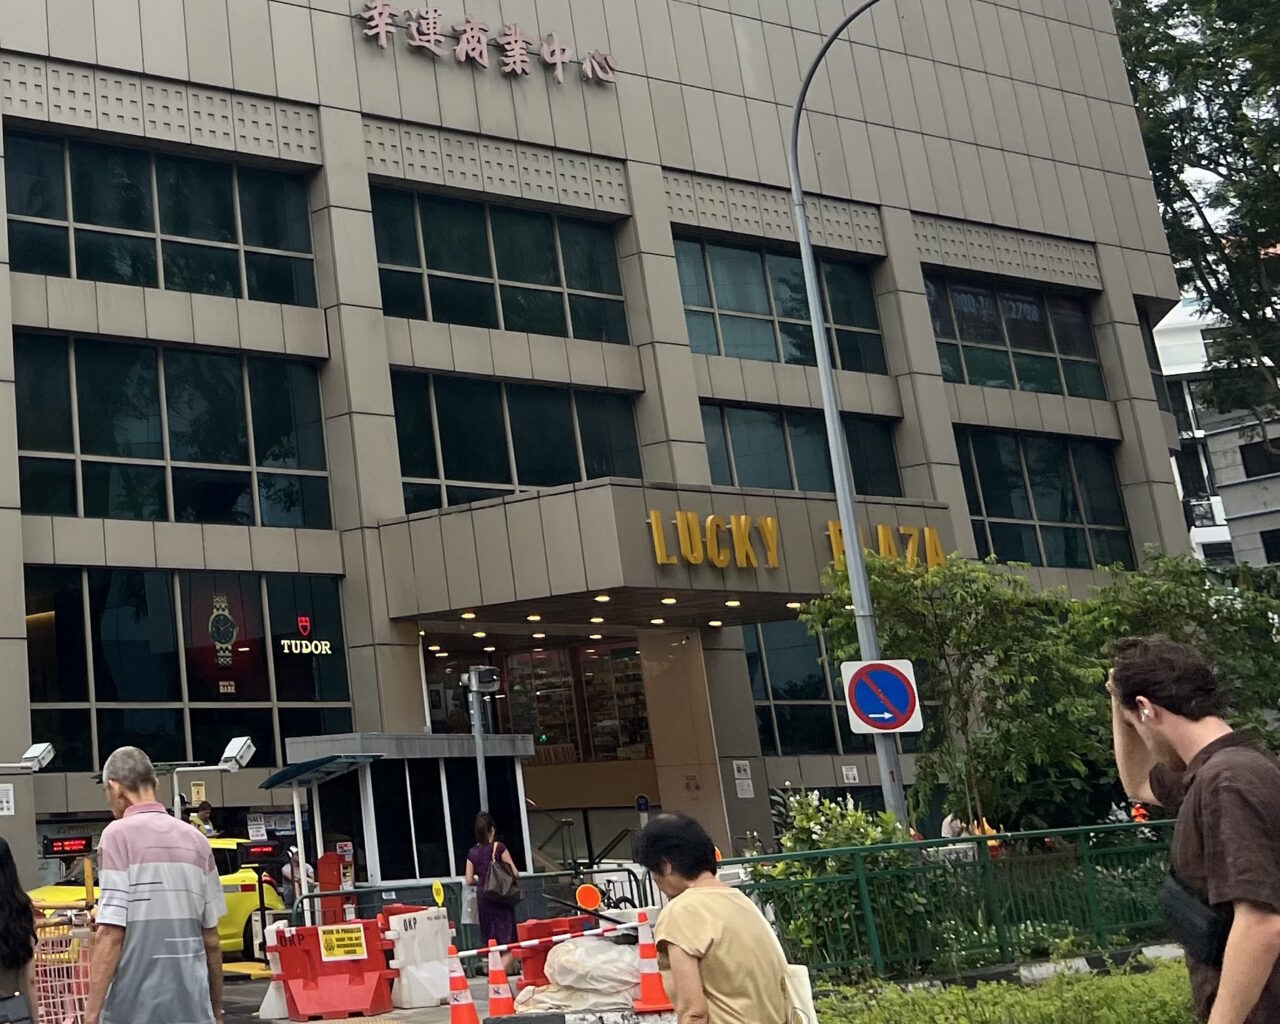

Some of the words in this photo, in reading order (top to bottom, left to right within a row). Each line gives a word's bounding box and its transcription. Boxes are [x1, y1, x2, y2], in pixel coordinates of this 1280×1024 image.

[648, 509, 781, 569] LUCKY
[827, 519, 948, 570] PAZA
[281, 639, 333, 655] TUDOR
[403, 917, 418, 931] OKP
